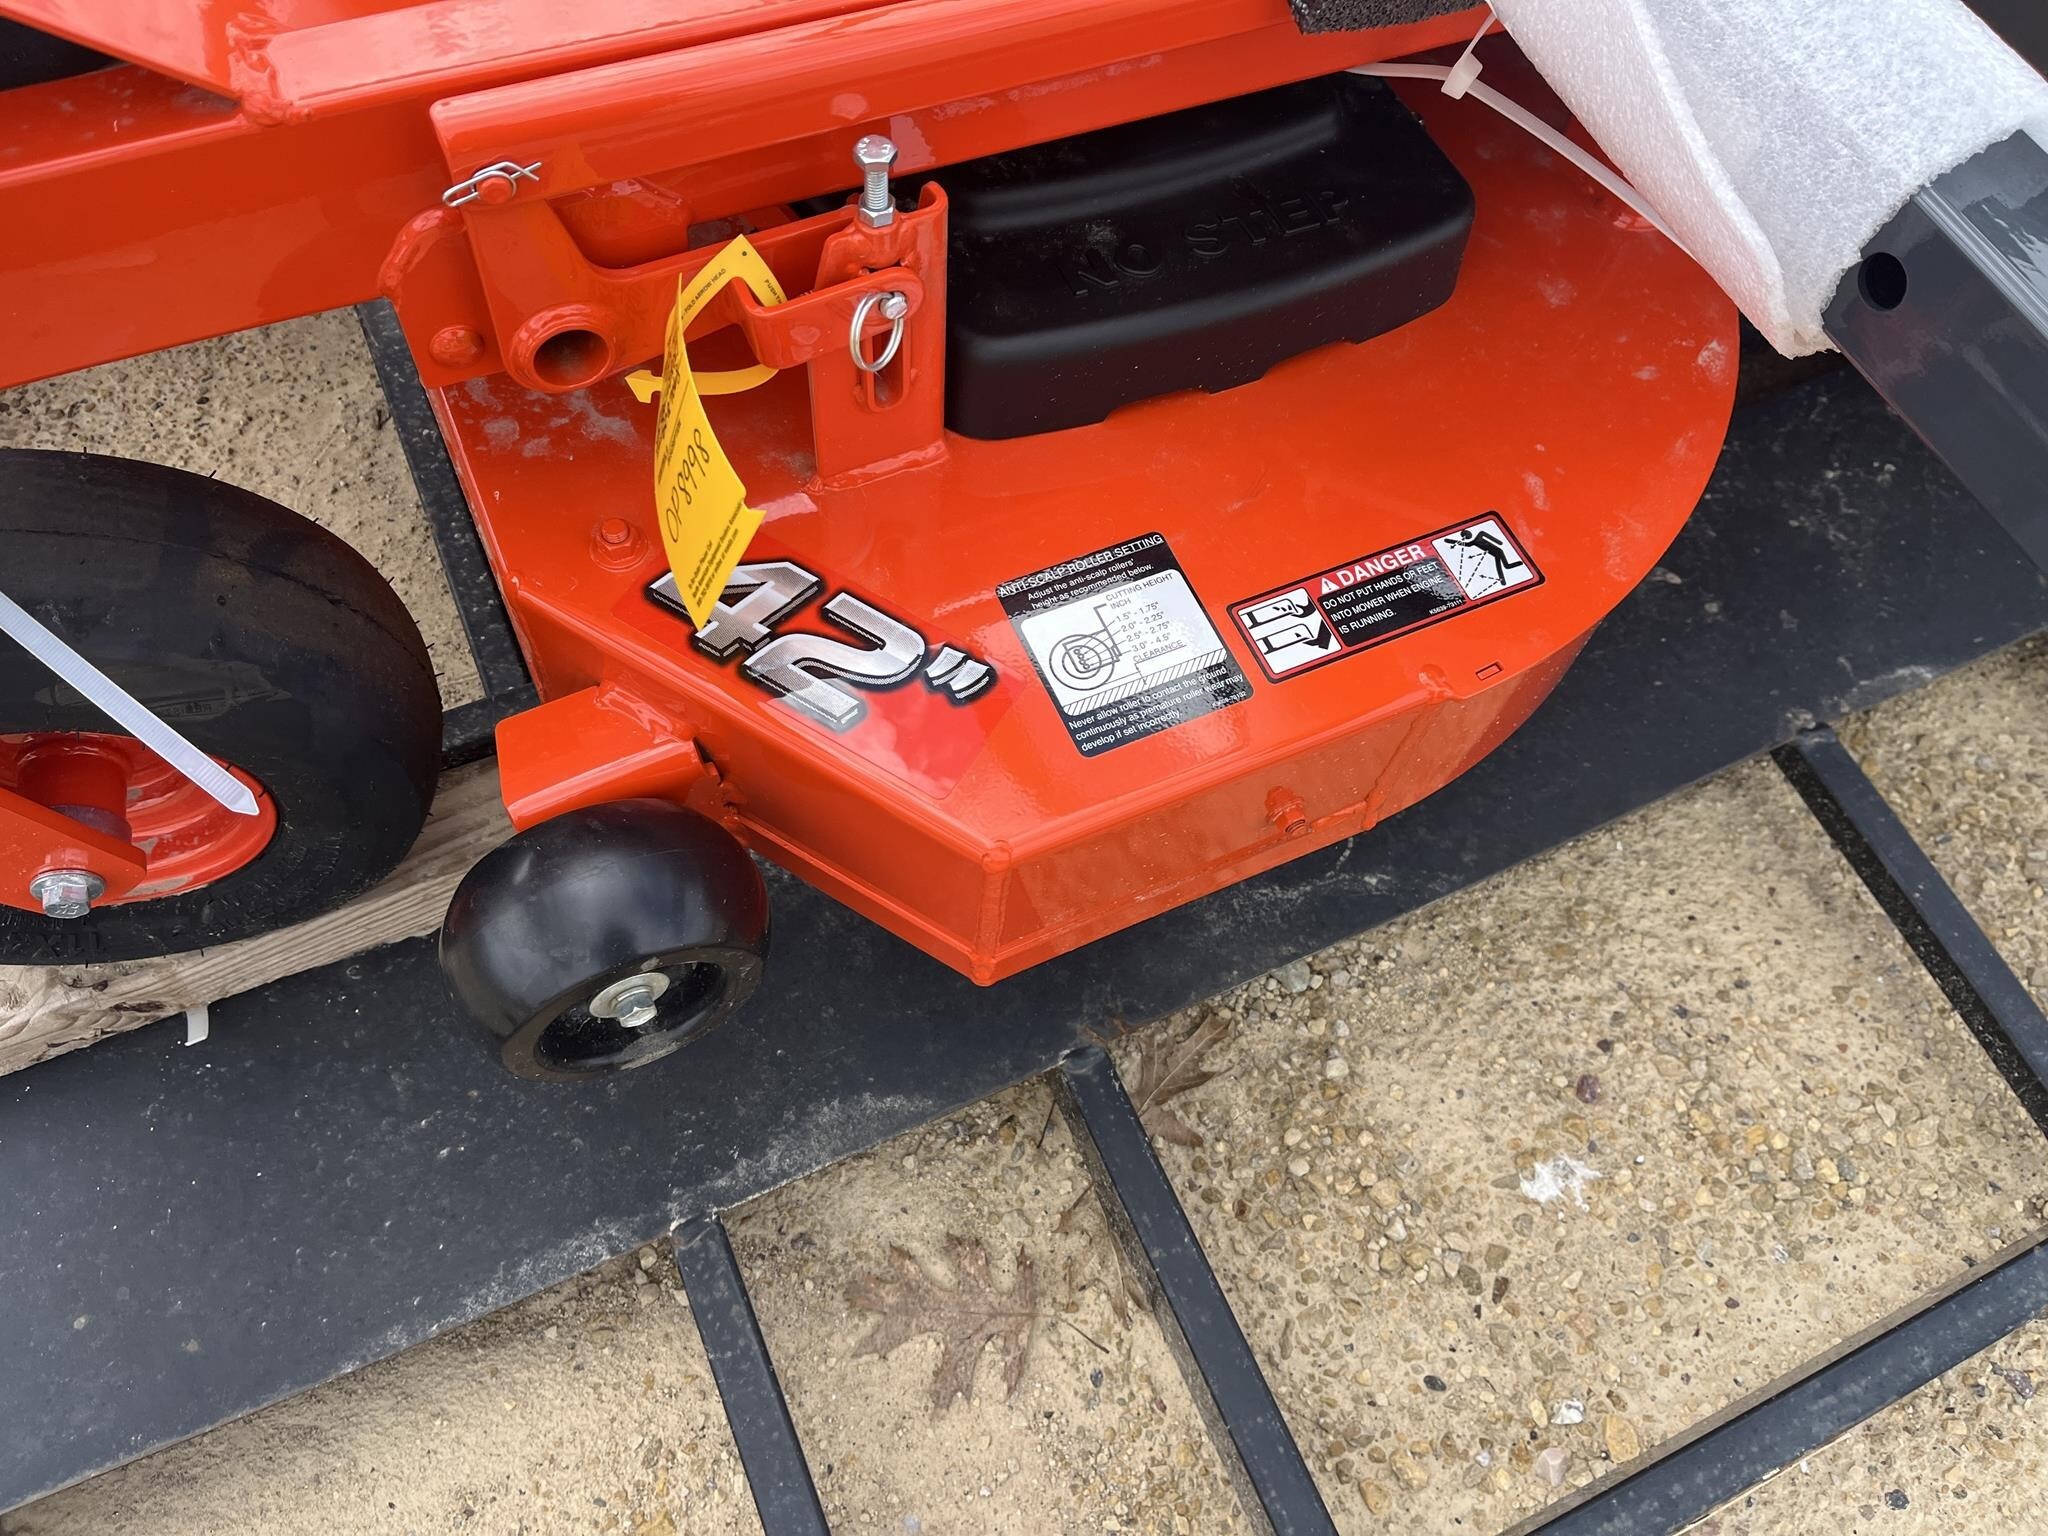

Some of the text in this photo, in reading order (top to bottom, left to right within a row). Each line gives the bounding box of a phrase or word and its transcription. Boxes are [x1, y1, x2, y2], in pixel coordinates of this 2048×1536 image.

[1067, 551, 1113, 573] ROLLER
[1113, 534, 1162, 557] SETTING
[1336, 544, 1427, 586] DANGER
[1027, 587, 1053, 600] Adjust
[1053, 582, 1067, 591] the
[1068, 568, 1108, 586] anti-scalp
[1031, 562, 1153, 609] height as recommended below.
[1105, 573, 1174, 601] CUTTING HEIGHT
[1109, 597, 1131, 609] INCH
[1323, 562, 1439, 610] DO NOT PUT HANDS OR FEET
[1331, 575, 1444, 621] INTO MOWER WHEN ENGINE
[1339, 608, 1397, 634] IS RUNNING.
[1132, 639, 1184, 663] CLEARANCE
[1069, 666, 1228, 730] Never allow roller to contact the ground
[1074, 673, 1244, 740] continuously as premature roller wear may
[1080, 732, 1115, 752] develop
[1114, 729, 1123, 738] if
[1122, 725, 1138, 735] set
